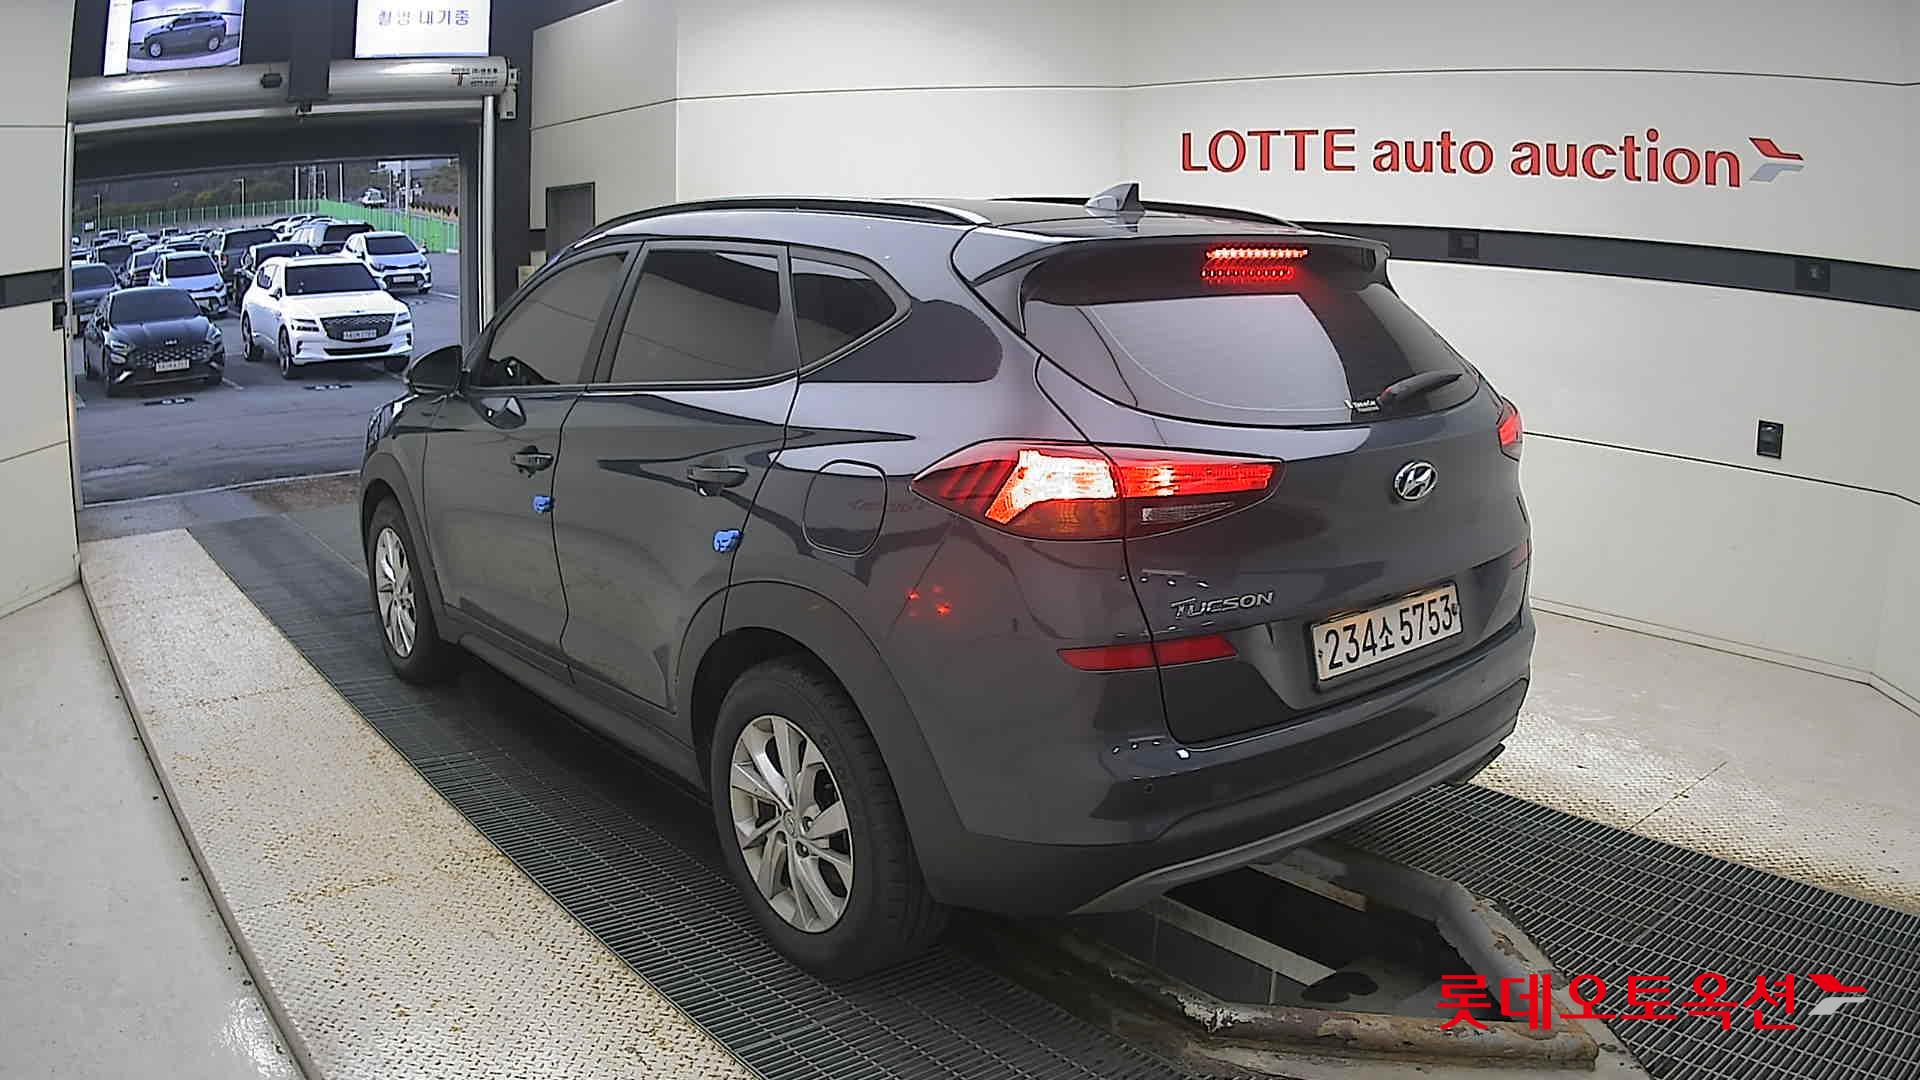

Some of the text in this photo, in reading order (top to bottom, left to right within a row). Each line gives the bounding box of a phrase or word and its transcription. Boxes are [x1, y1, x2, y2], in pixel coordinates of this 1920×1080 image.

[1181, 128, 1741, 188] LOTTE auto auction
[1171, 591, 1274, 618] TUCSON
